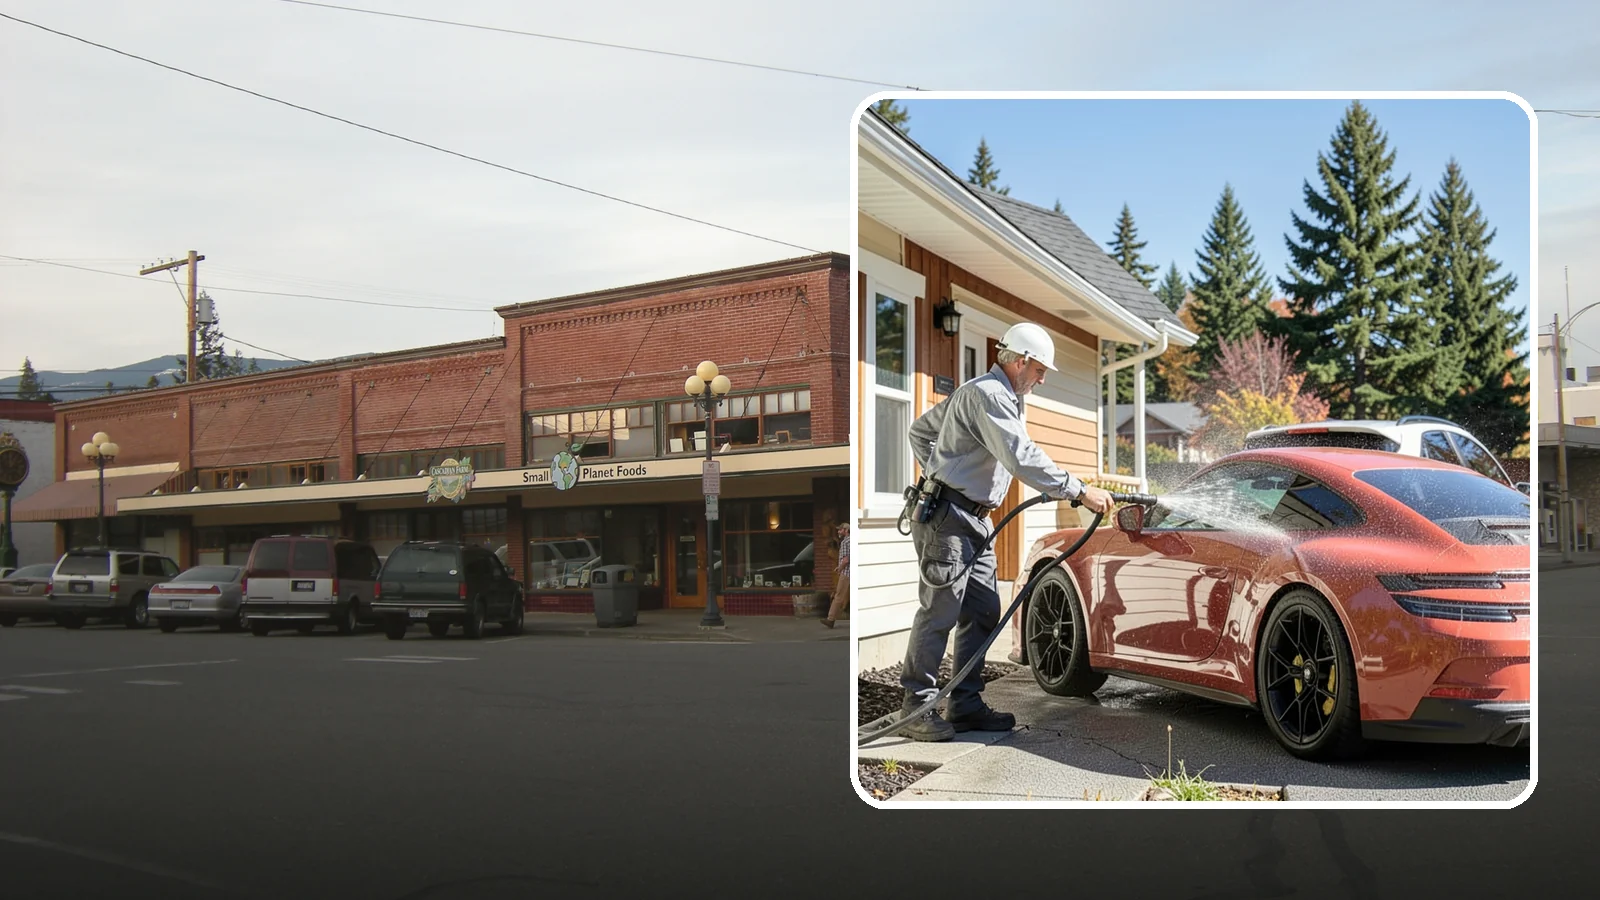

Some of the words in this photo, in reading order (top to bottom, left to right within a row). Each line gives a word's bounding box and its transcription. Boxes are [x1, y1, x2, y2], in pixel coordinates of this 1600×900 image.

[522, 470, 549, 483] Small
[582, 466, 614, 479] Planet
[616, 464, 647, 477] Foods
